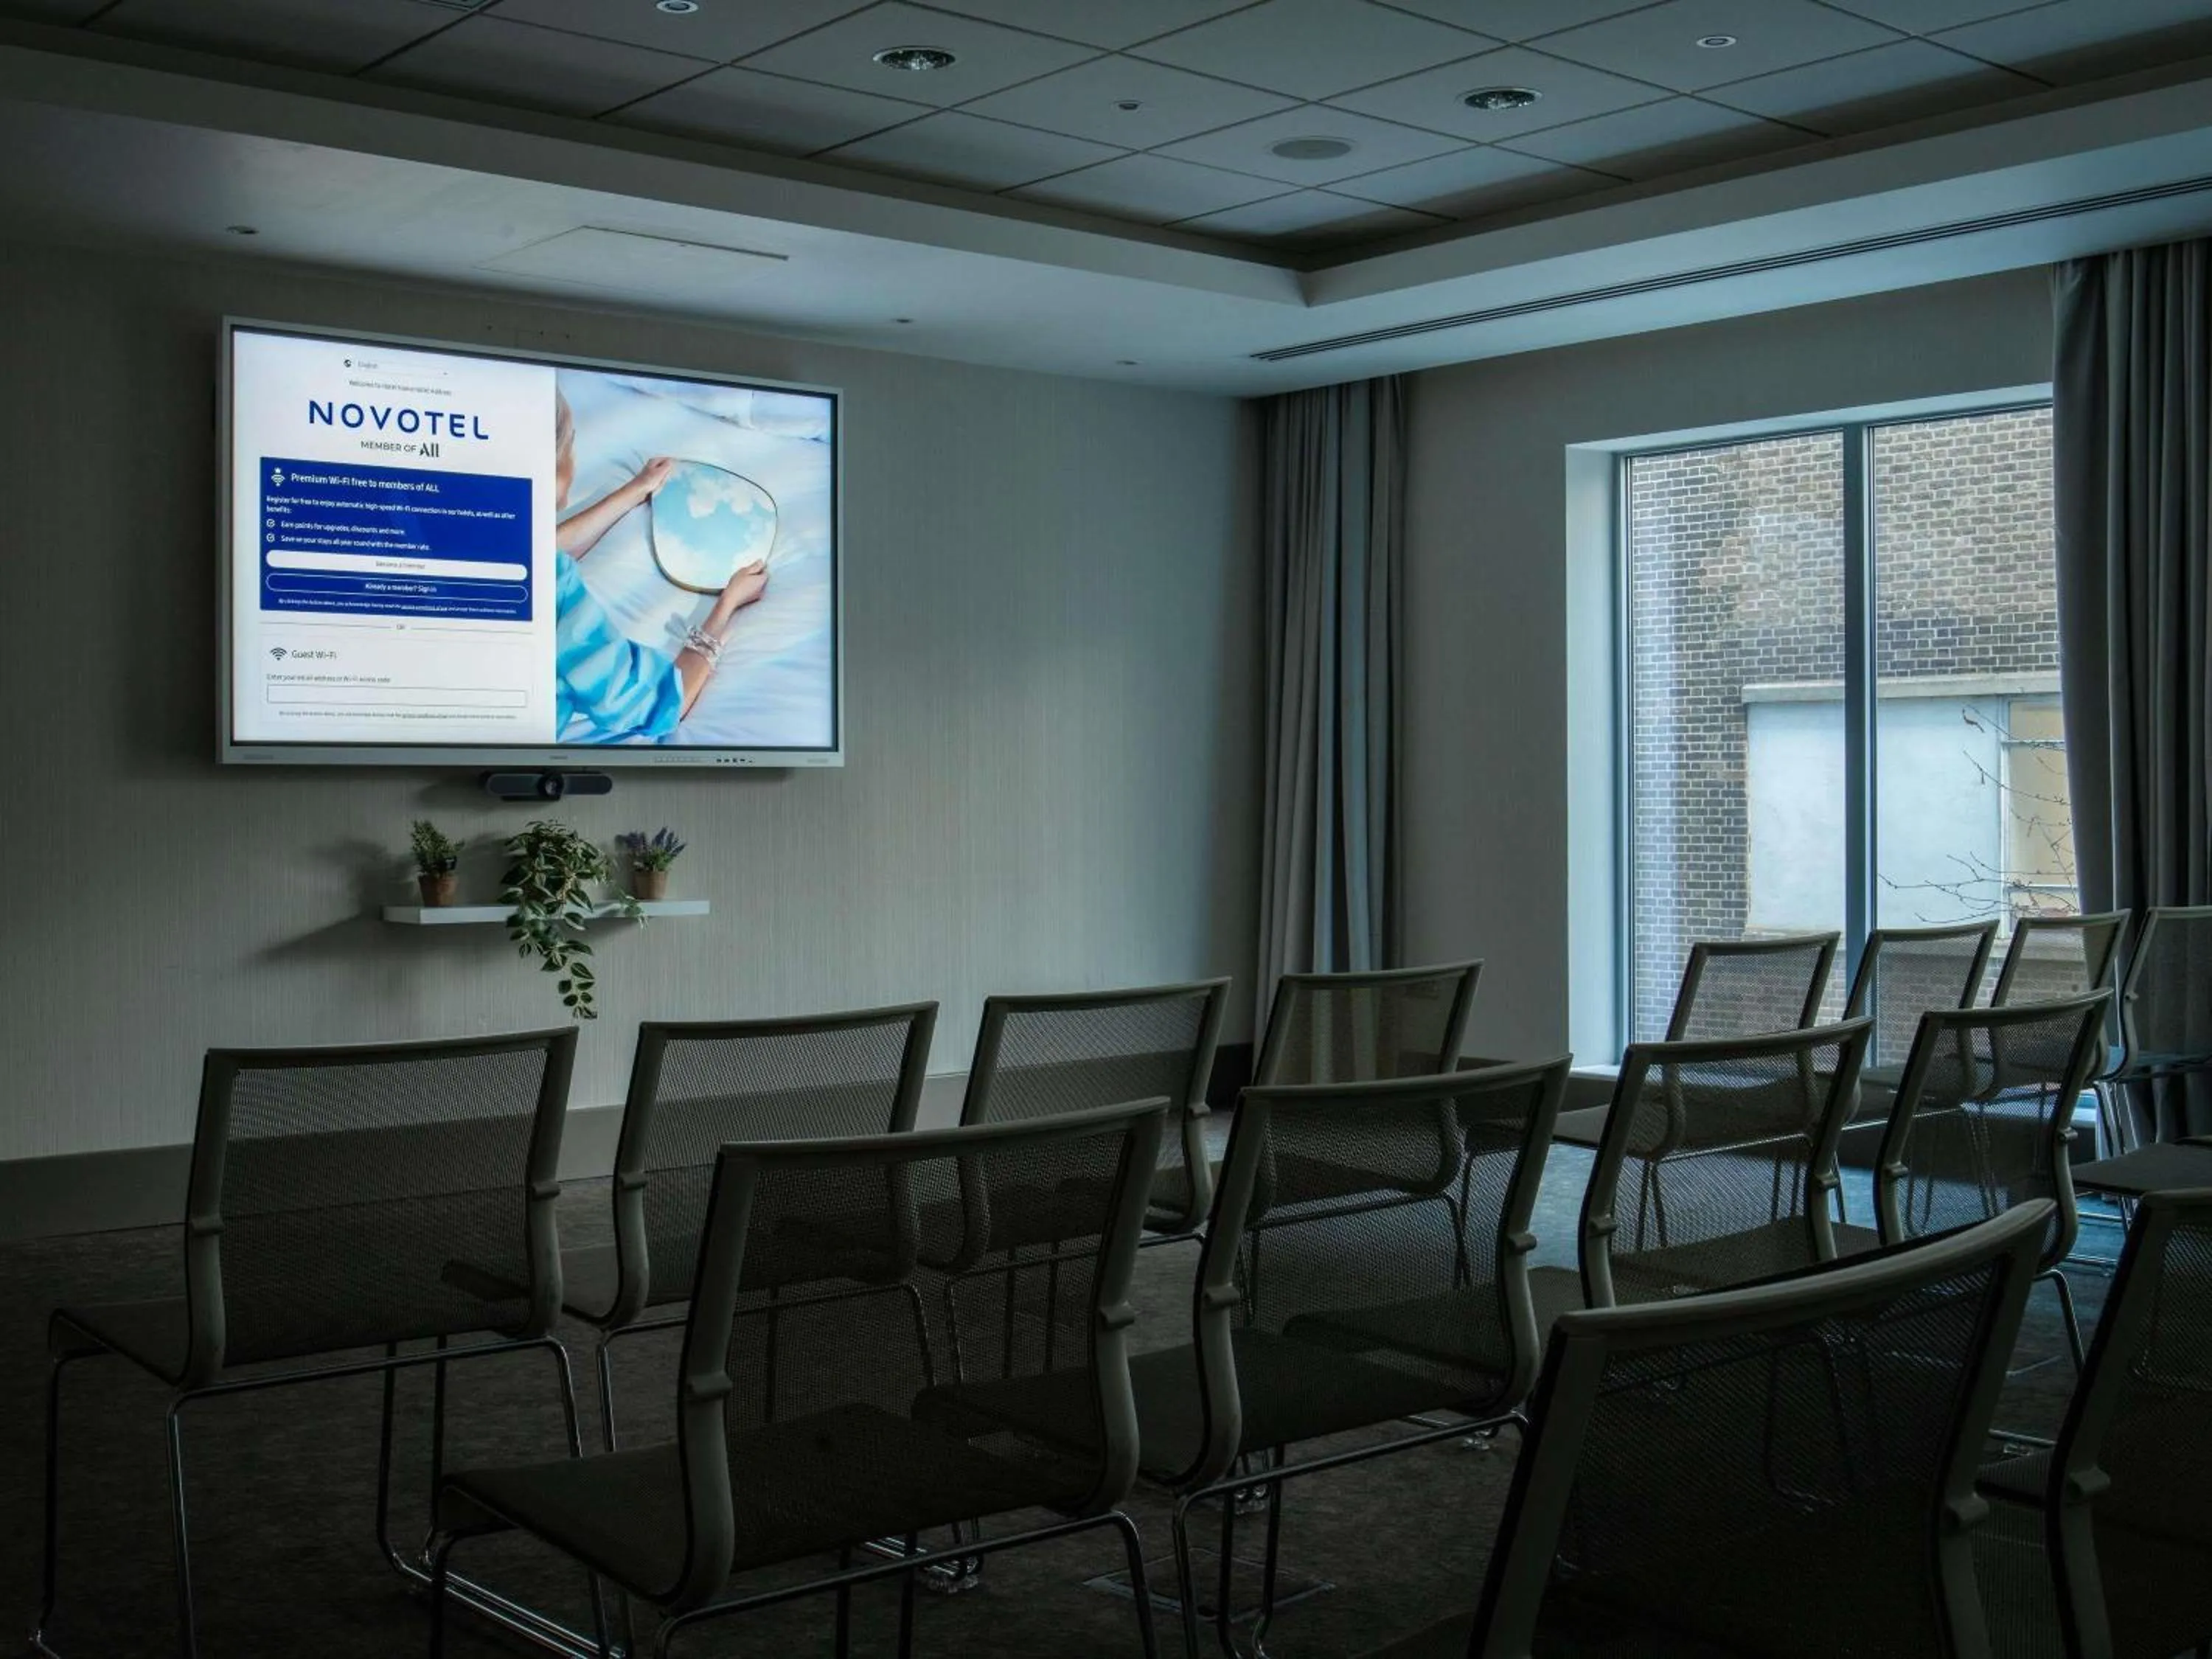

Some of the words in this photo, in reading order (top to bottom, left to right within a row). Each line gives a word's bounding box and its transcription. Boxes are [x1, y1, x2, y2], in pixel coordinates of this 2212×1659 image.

[309, 400, 489, 440] NOVOTEL
[361, 441, 401, 452] MEMBER
[403, 444, 417, 452] OF
[419, 442, 439, 458] All
[291, 473, 327, 484] Premium
[328, 476, 350, 486] Wi-Fi
[351, 478, 367, 487] free
[368, 479, 377, 487] to
[378, 481, 414, 491] members
[415, 483, 425, 492] of
[425, 484, 440, 493] ALL
[266, 495, 289, 504] Register
[319, 500, 335, 508] enjoy
[365, 502, 395, 511] high-speed
[291, 650, 313, 659] Guest
[315, 650, 337, 659] Wi-Fi
